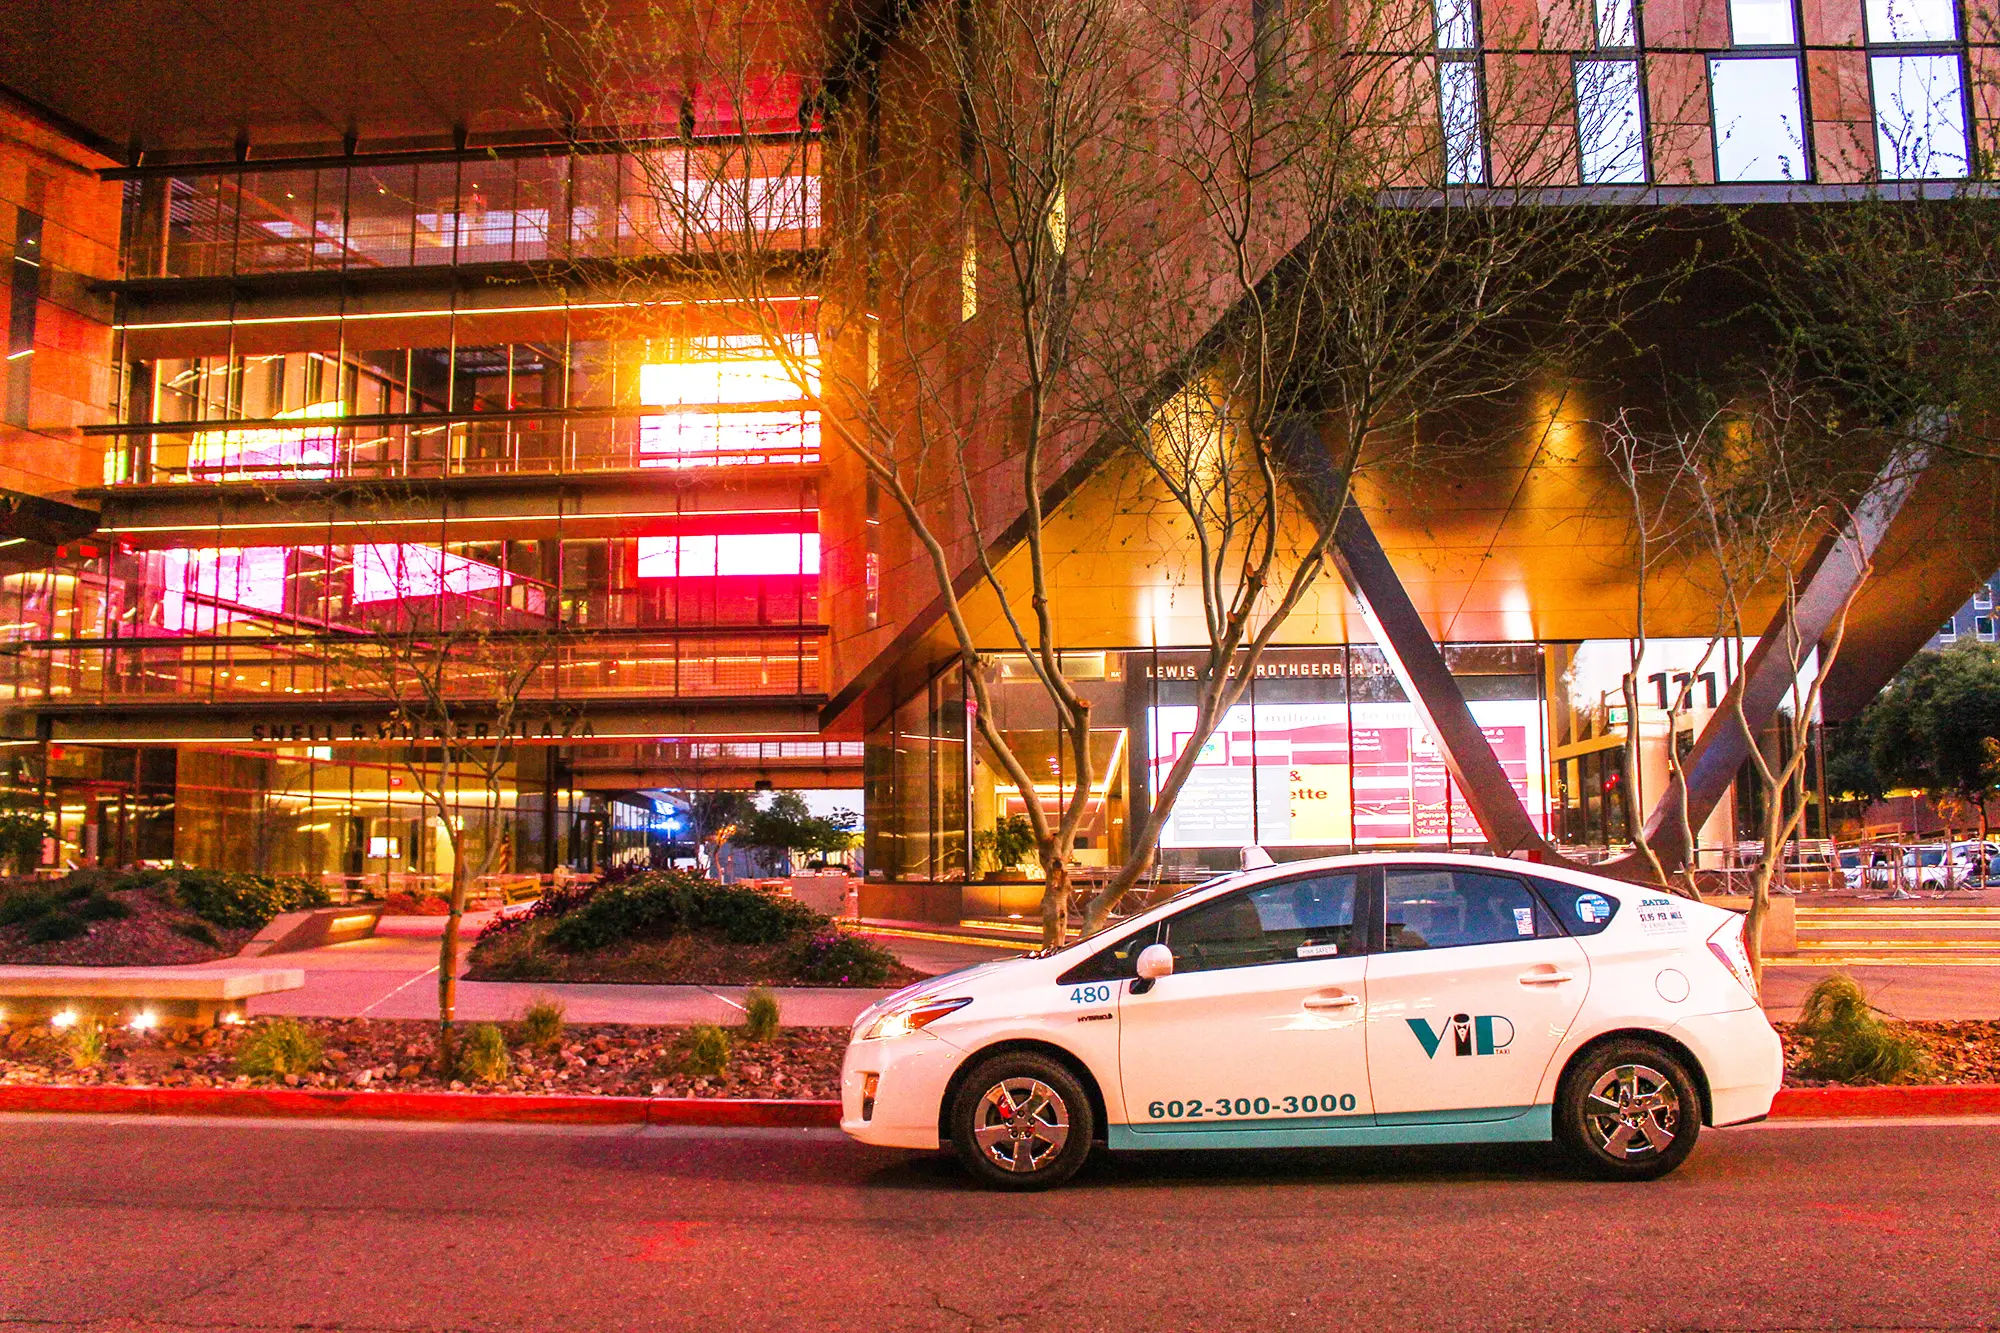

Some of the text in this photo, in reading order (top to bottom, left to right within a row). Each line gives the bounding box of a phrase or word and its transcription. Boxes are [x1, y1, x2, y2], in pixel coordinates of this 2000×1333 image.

[1146, 665, 1196, 678] LEWIS
[1648, 671, 1718, 710] 111
[252, 723, 334, 739] SNELL
[351, 723, 366, 739] &
[375, 722, 489, 739] WILER
[1641, 898, 1670, 906] RATES
[1070, 985, 1110, 1004] 480
[1077, 1014, 1108, 1023] HYBRID
[1148, 1093, 1356, 1119] 602-300-3000
